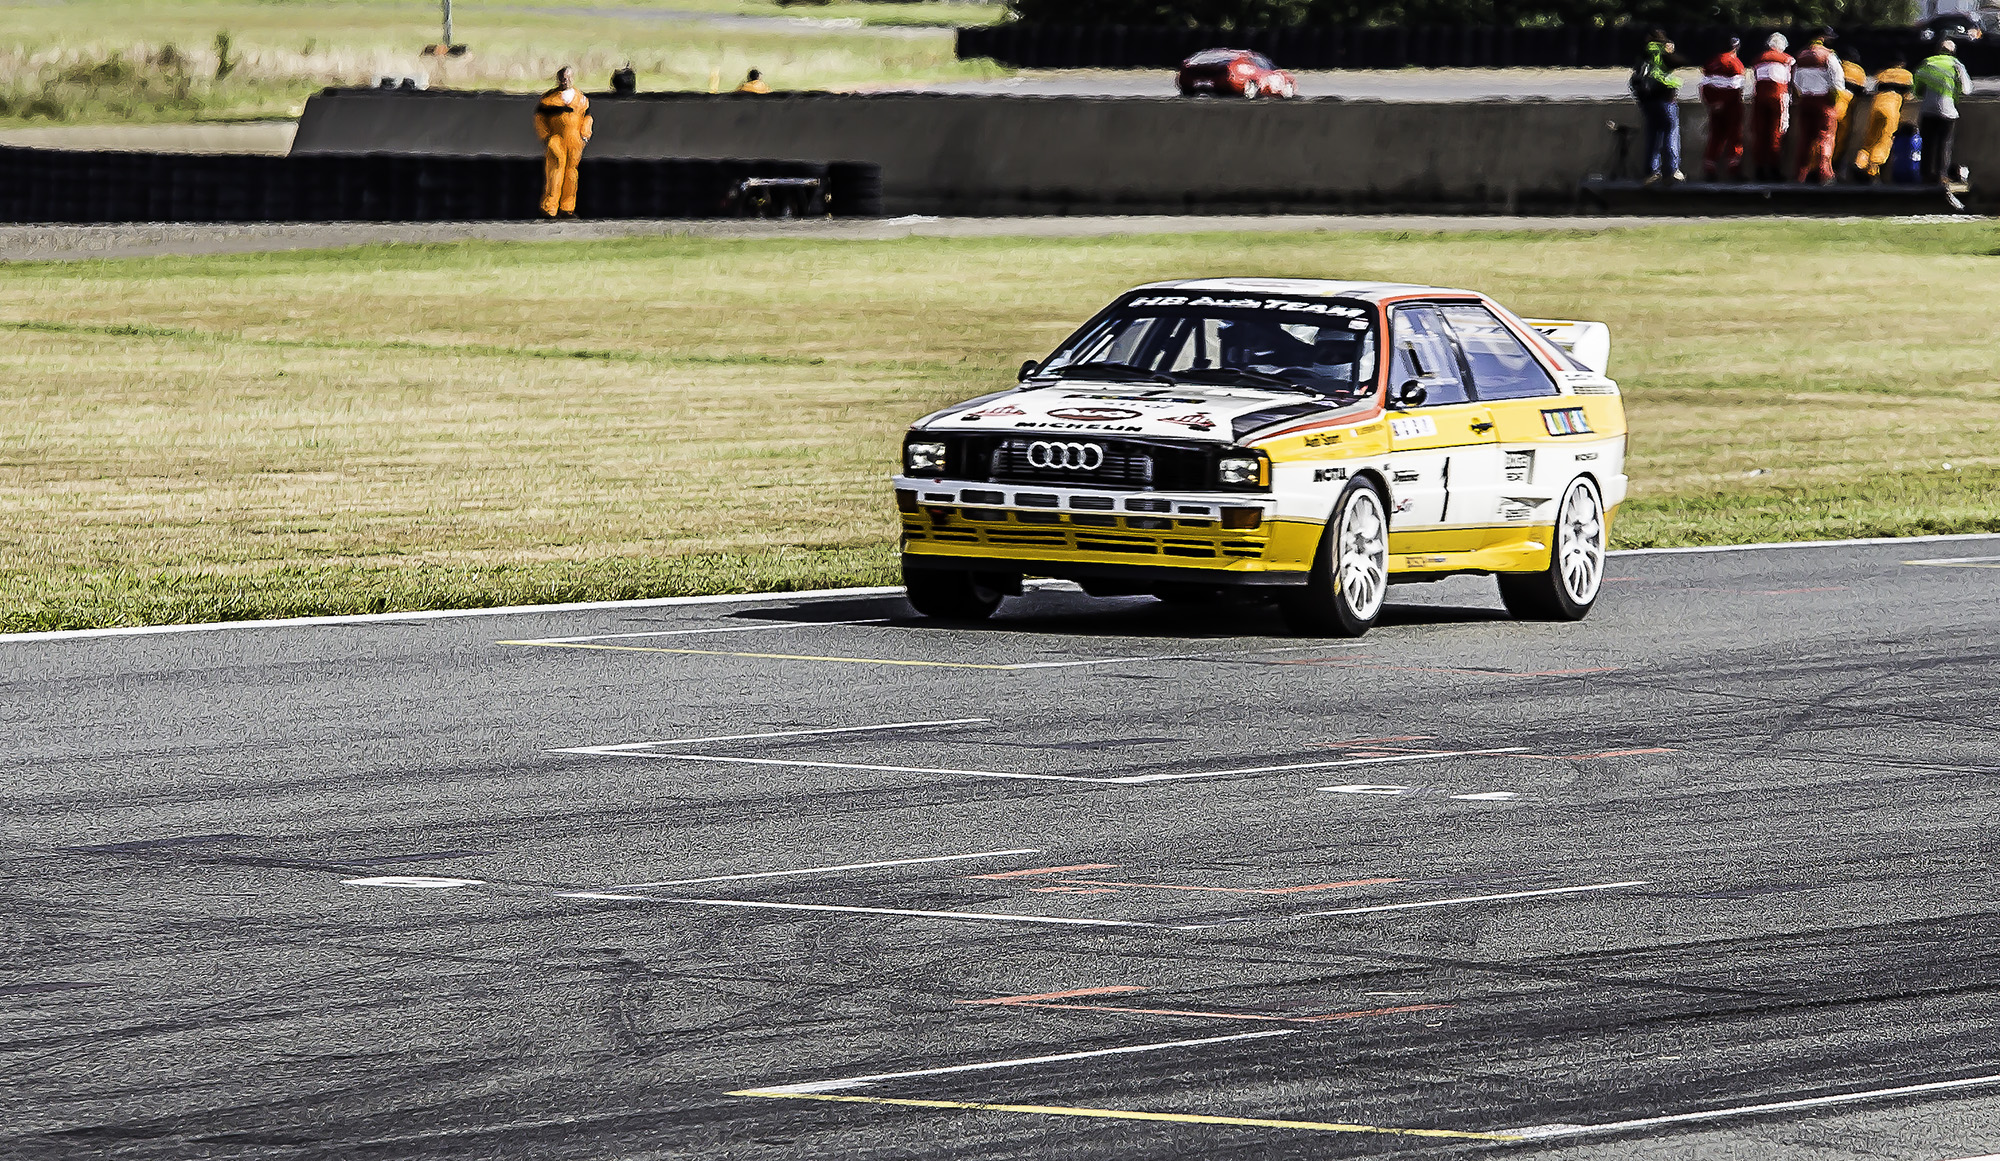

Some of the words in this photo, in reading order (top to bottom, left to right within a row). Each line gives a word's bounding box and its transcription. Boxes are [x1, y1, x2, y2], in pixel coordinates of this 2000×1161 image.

[1128, 296, 1188, 307] HB
[1264, 299, 1366, 317] TEAM
[1015, 422, 1143, 432] MICHELIN
[1438, 456, 1450, 522] 1
